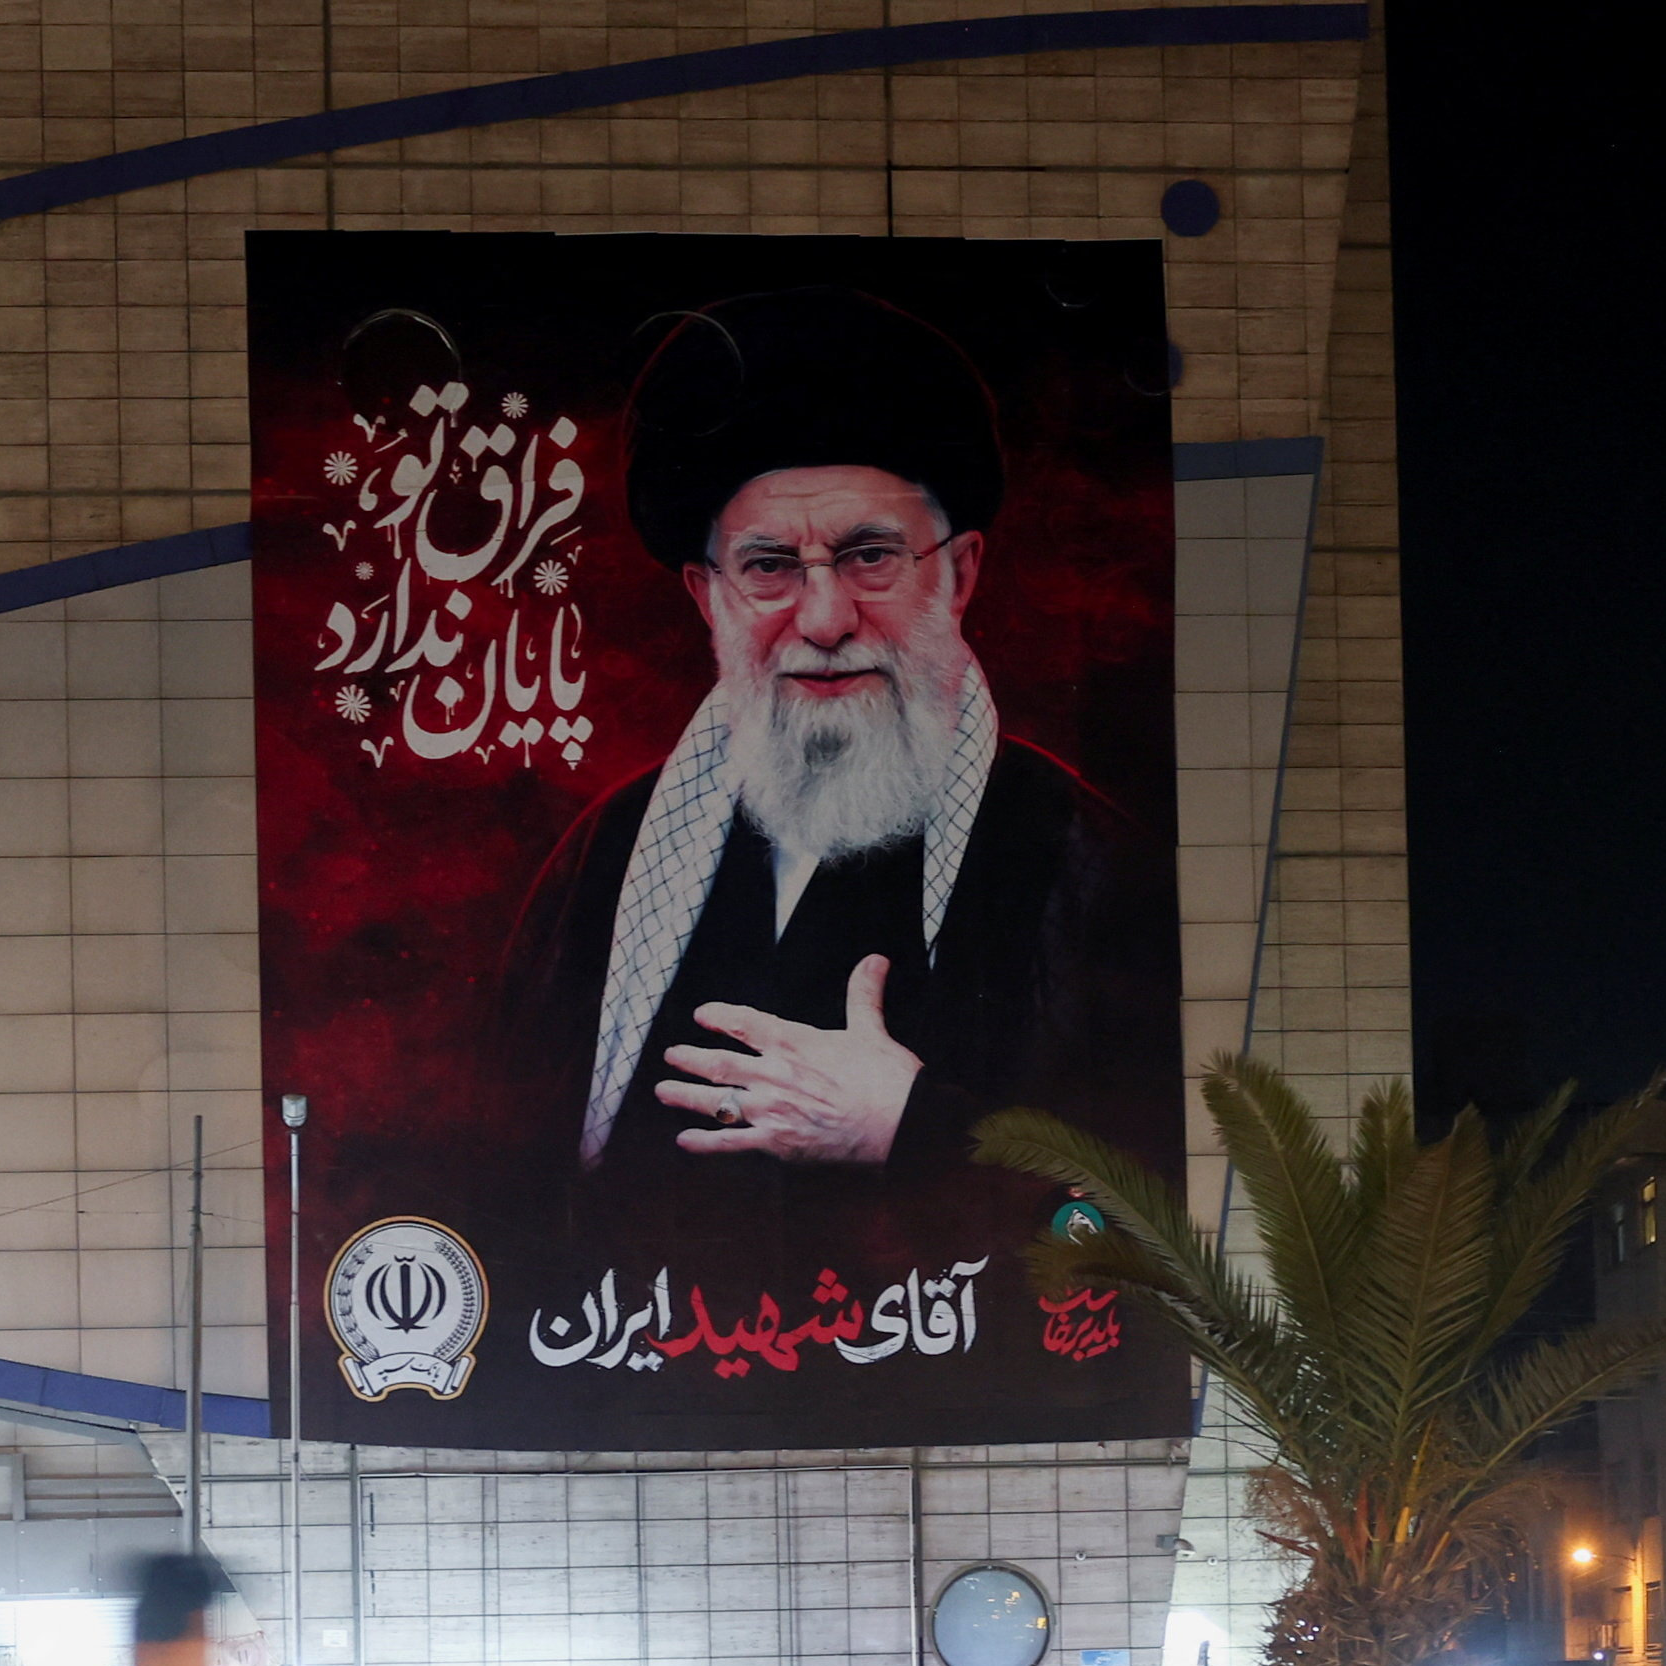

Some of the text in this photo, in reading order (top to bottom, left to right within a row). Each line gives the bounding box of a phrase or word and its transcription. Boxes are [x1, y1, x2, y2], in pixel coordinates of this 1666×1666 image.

[415, 416, 586, 590] فراق
[314, 557, 593, 768] پایان ندارد
[377, 1356, 442, 1383] بانک سپه
[528, 1254, 993, 1379] آقای شهید ایران
[1077, 1305, 1122, 1358] باید
